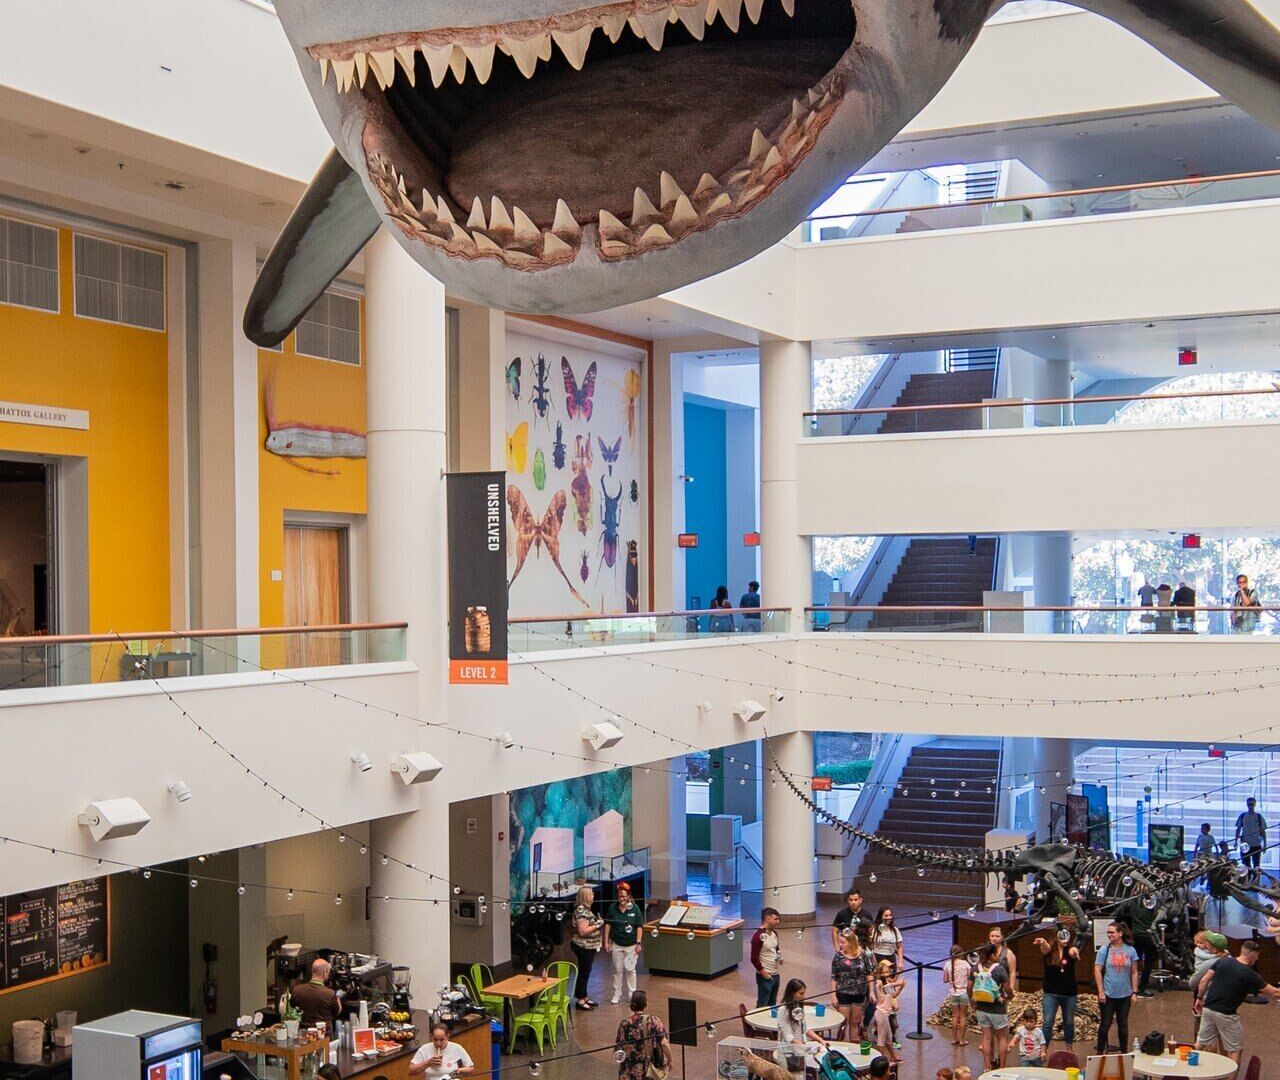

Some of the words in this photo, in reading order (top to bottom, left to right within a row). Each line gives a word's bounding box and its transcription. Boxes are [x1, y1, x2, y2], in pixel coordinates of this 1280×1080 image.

[0, 407, 32, 419] HATTOX
[33, 410, 68, 421] GALLERY
[487, 483, 500, 552] UNSHELVED
[460, 667, 488, 679] LEVEL
[490, 667, 497, 679] 2
